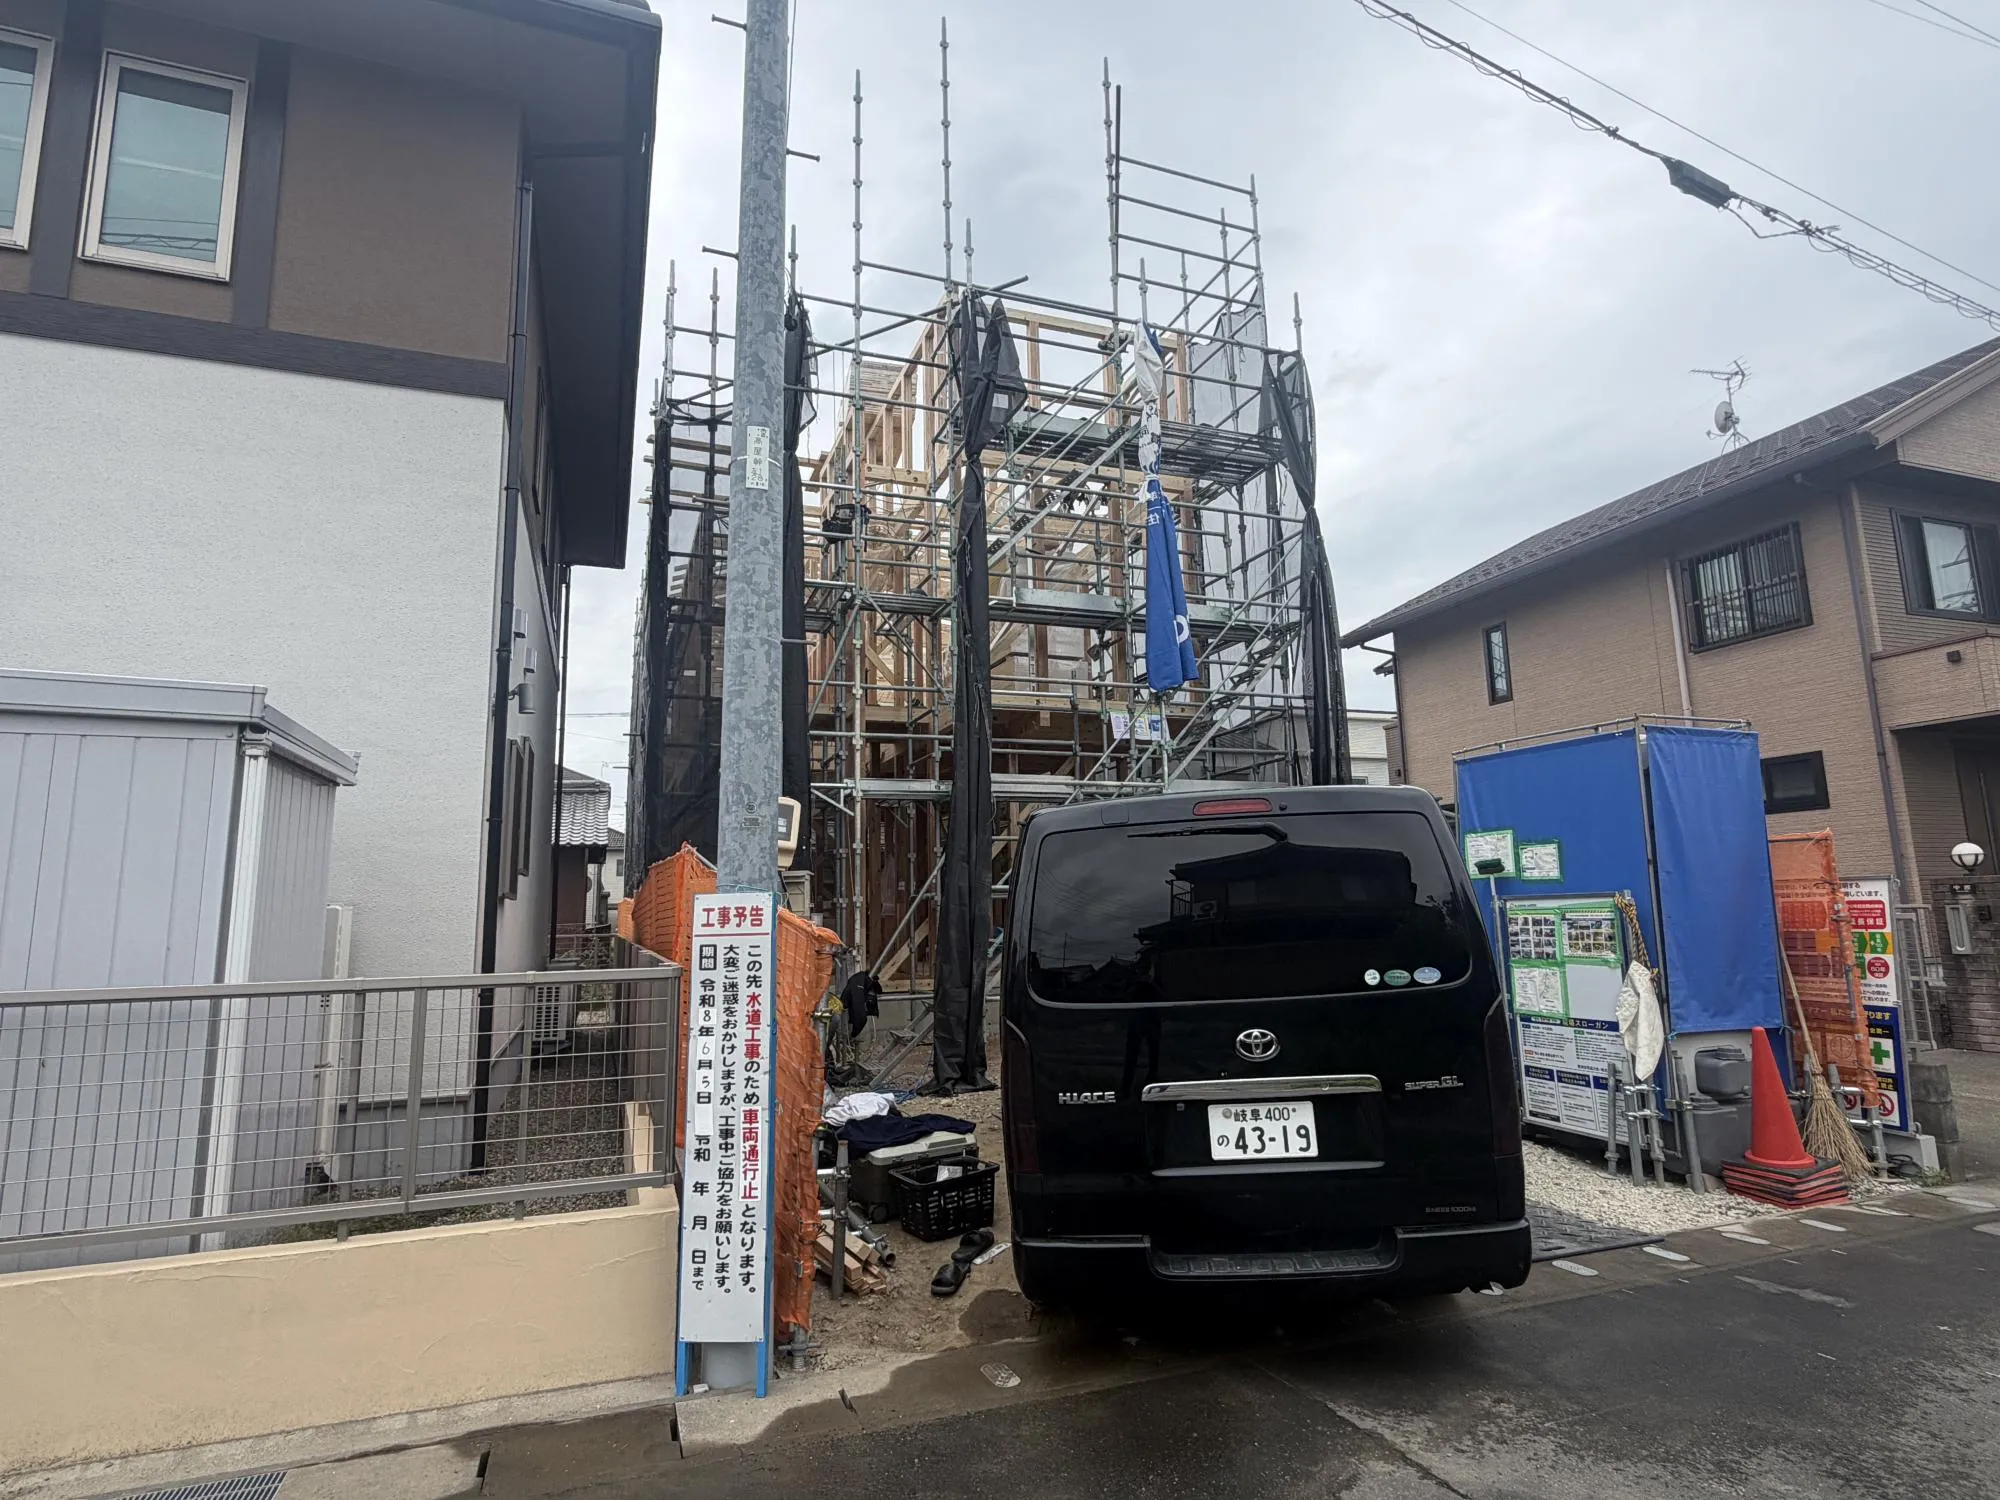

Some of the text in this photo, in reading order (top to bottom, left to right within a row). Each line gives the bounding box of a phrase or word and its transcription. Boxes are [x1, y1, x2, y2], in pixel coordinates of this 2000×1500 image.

[701, 905, 764, 929] 工事予告
[700, 945, 717, 970] 期間
[1058, 1091, 1117, 1105] HIACE
[714, 944, 740, 1294] 大変ご迷惑をおかけしますが、工事中ご協力をお願いします。
[1217, 1124, 1312, 1155] の 43-19
[692, 1181, 710, 1196] 年
[691, 1215, 708, 1231] 月
